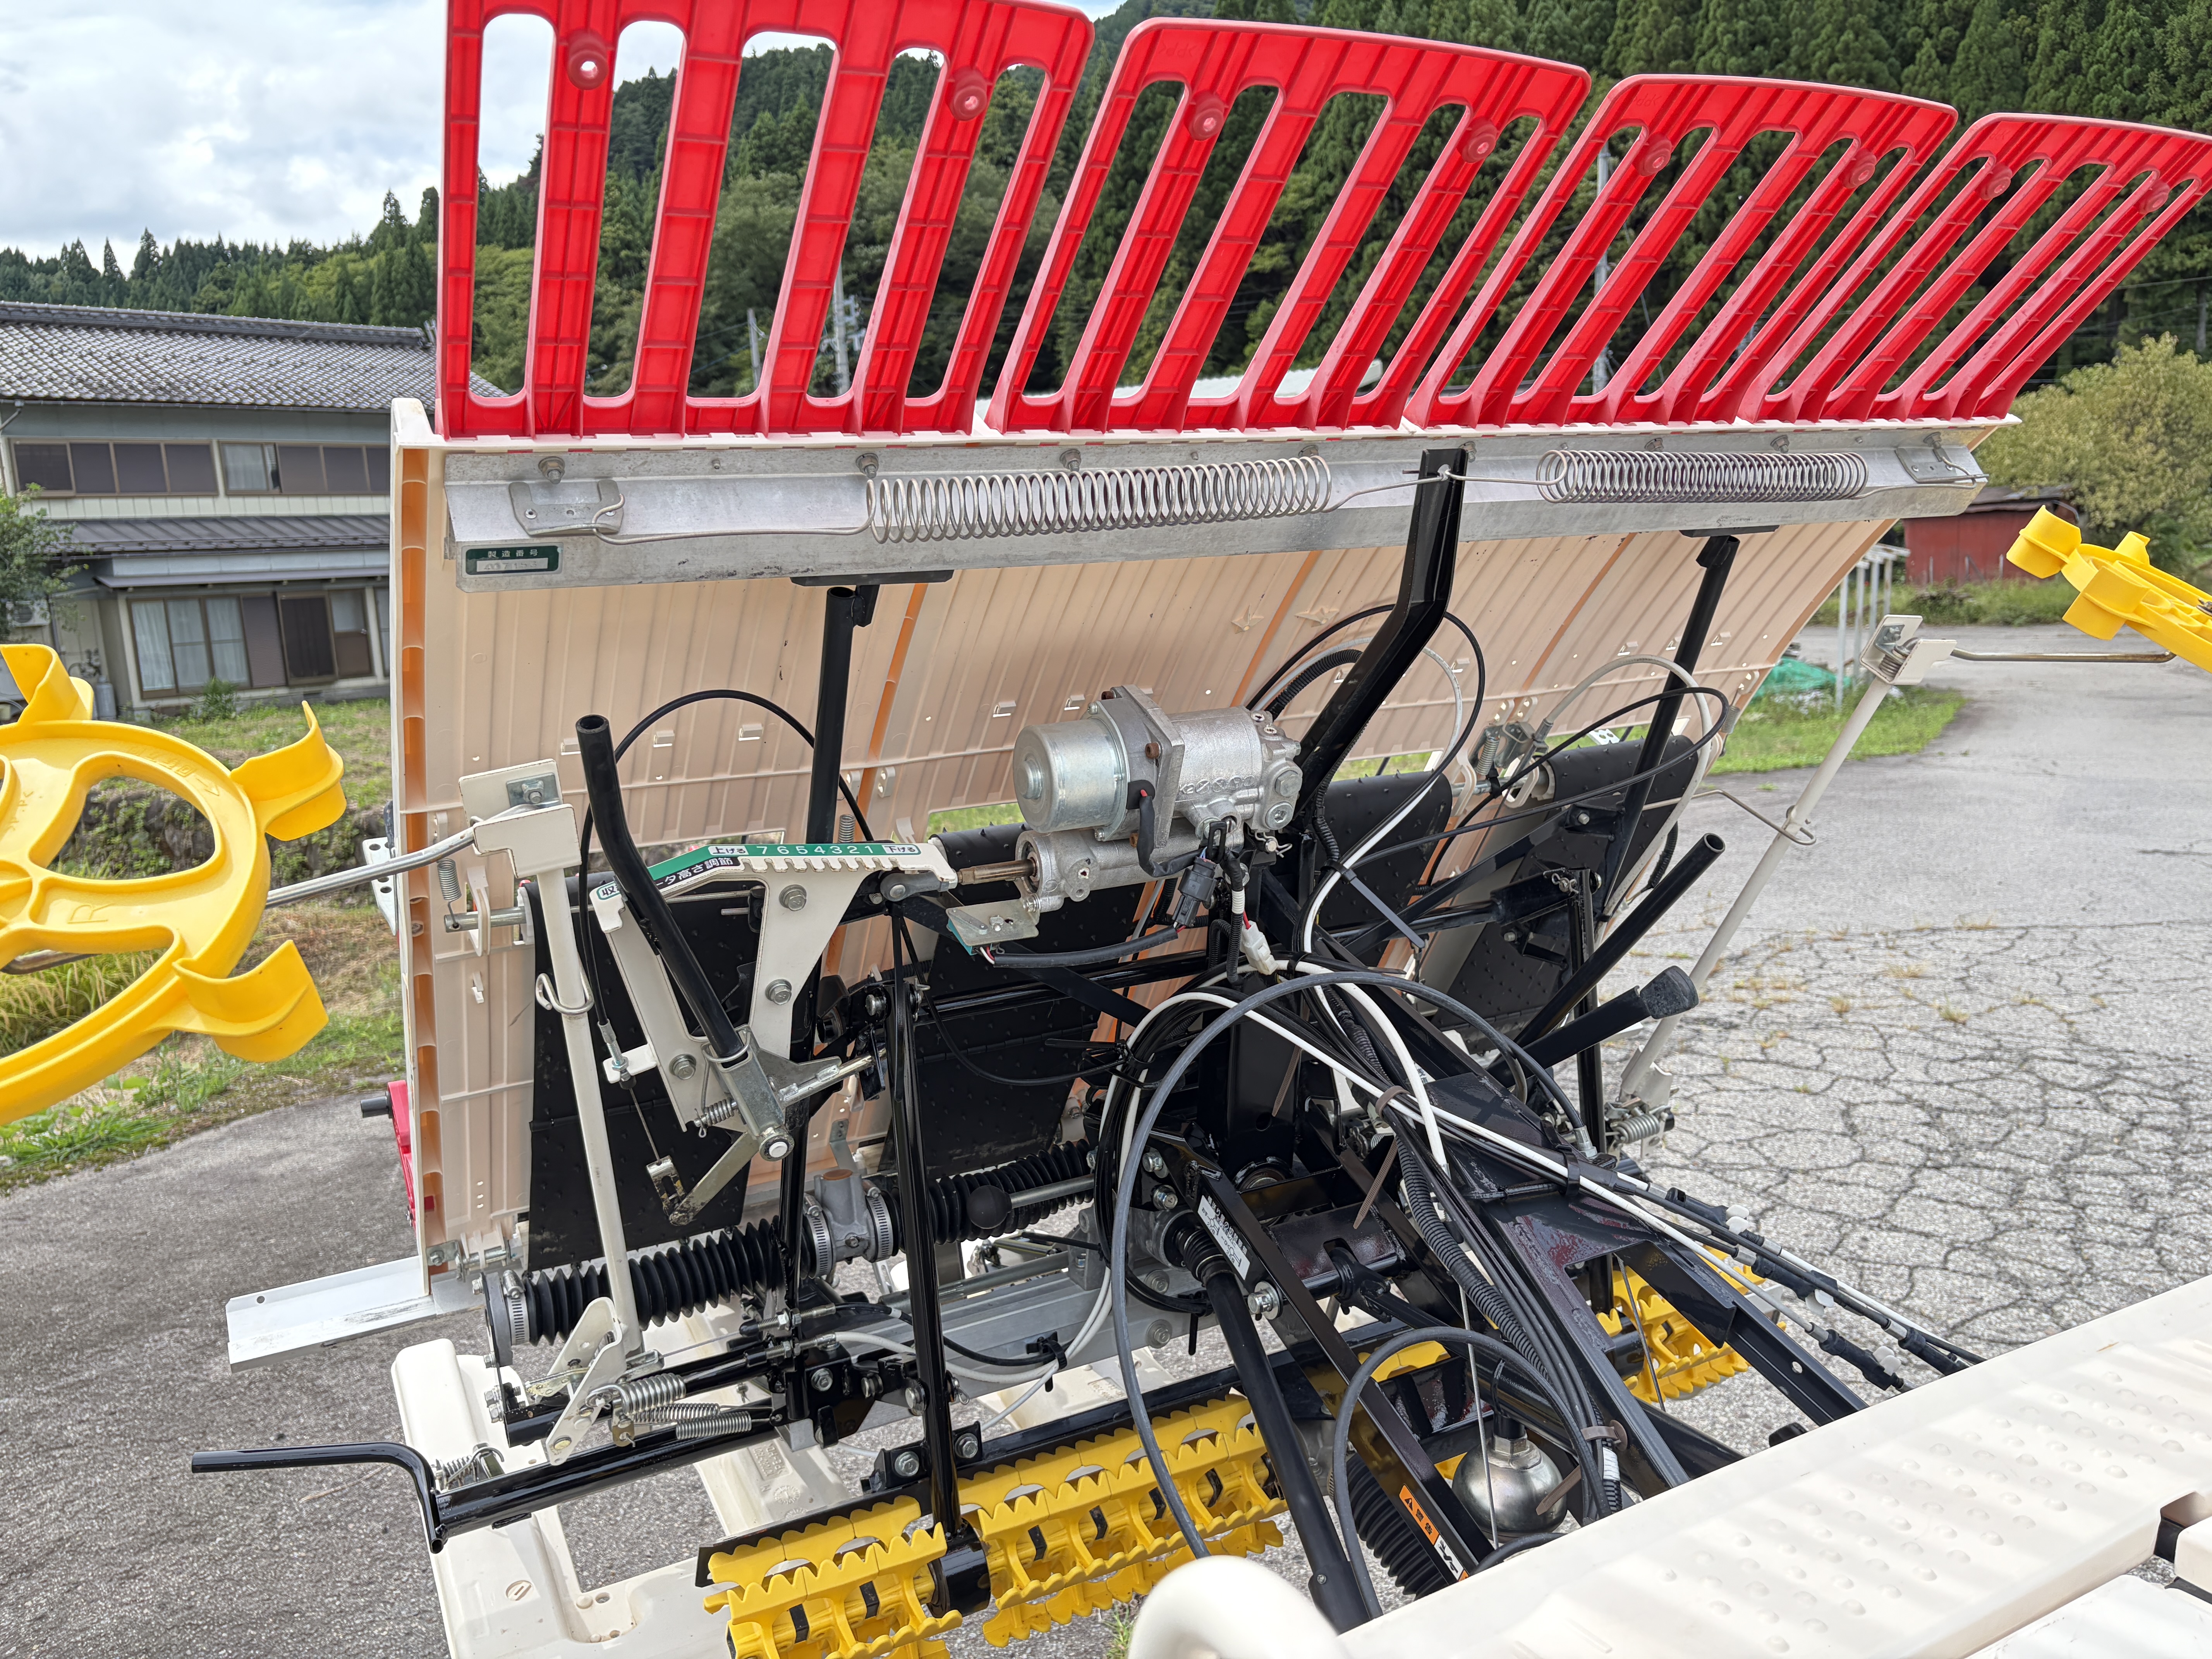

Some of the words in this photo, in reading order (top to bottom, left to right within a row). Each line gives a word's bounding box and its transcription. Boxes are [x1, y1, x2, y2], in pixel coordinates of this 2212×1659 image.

[488, 549, 538, 558] 製造番号
[756, 846, 768, 854] 7
[777, 846, 790, 854] 6
[795, 846, 808, 854] 5
[814, 846, 826, 854] 4
[830, 846, 842, 854] 3
[847, 846, 860, 854] 2
